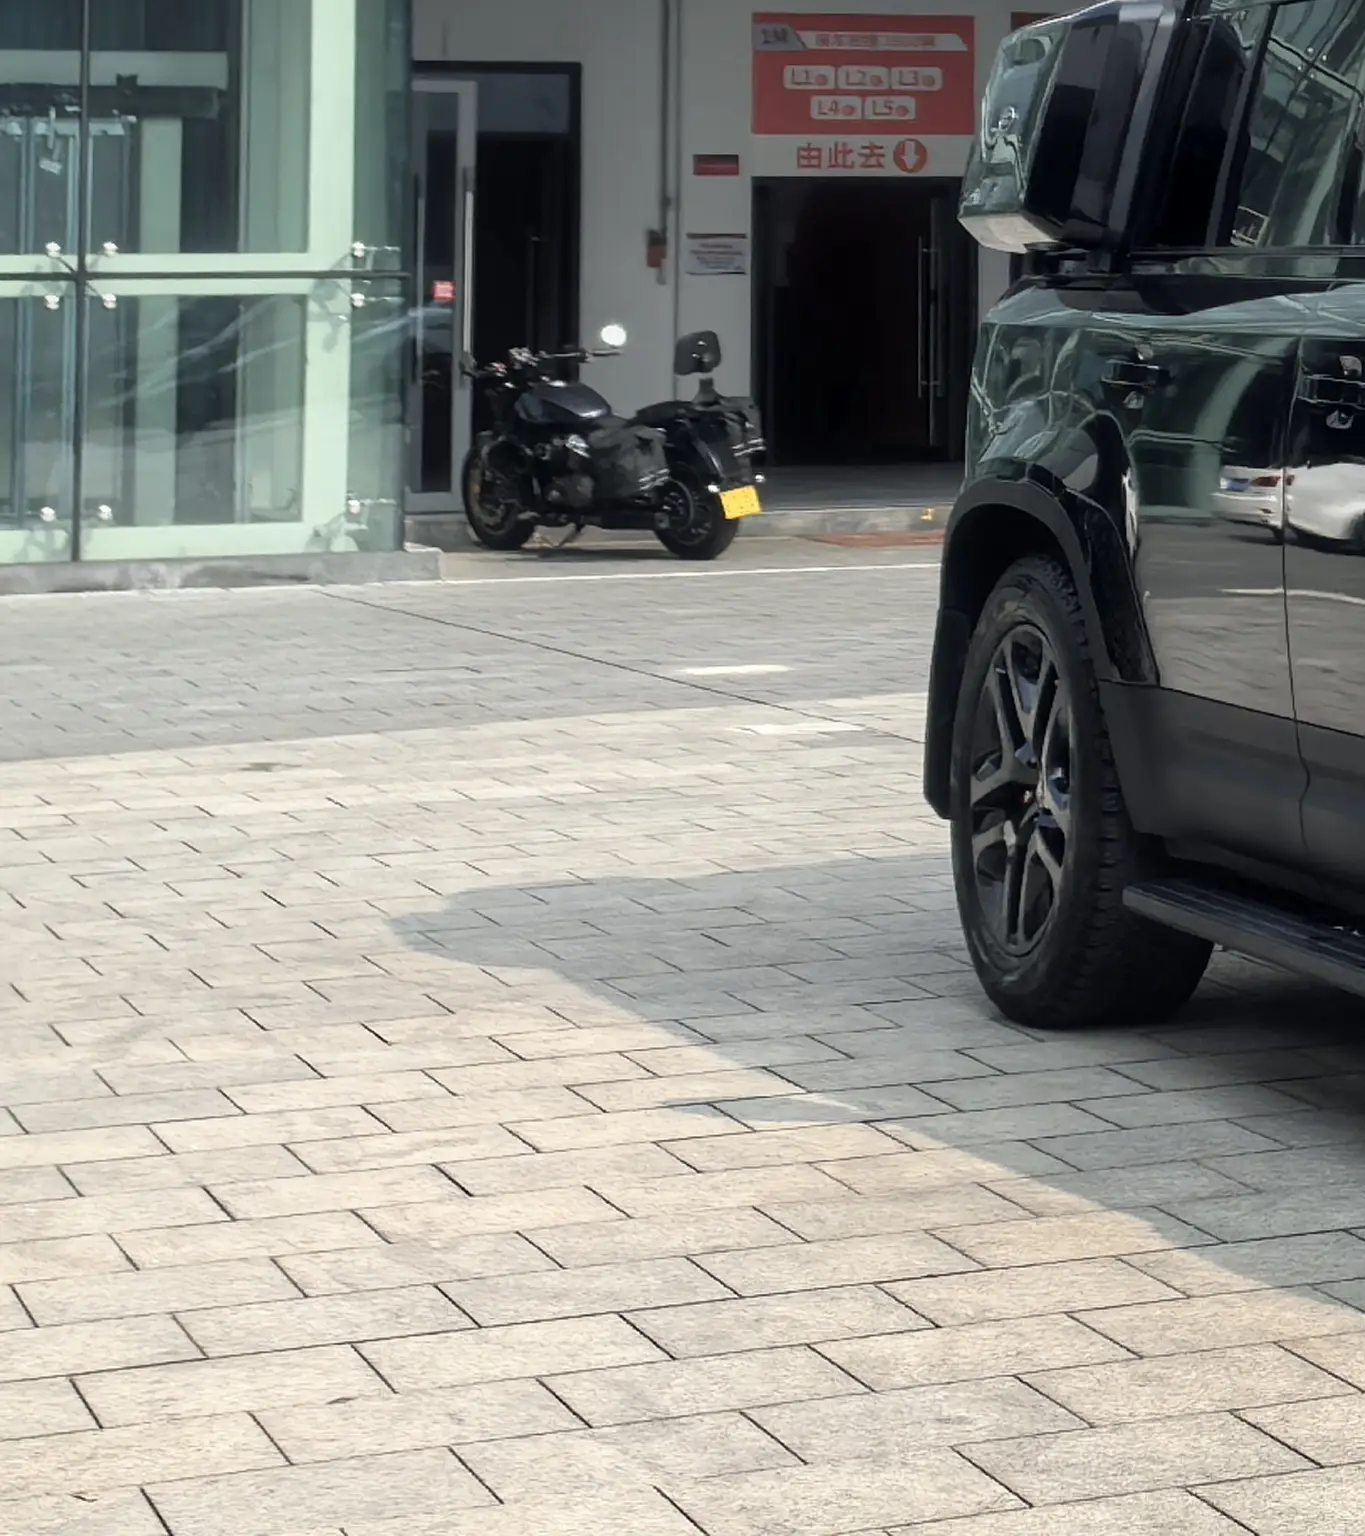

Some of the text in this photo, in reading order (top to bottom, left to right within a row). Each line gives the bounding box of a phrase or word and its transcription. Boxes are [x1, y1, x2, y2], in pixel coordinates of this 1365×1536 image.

[845, 69, 867, 86] L2
[898, 70, 919, 86] L3
[796, 141, 886, 170] 由此去
